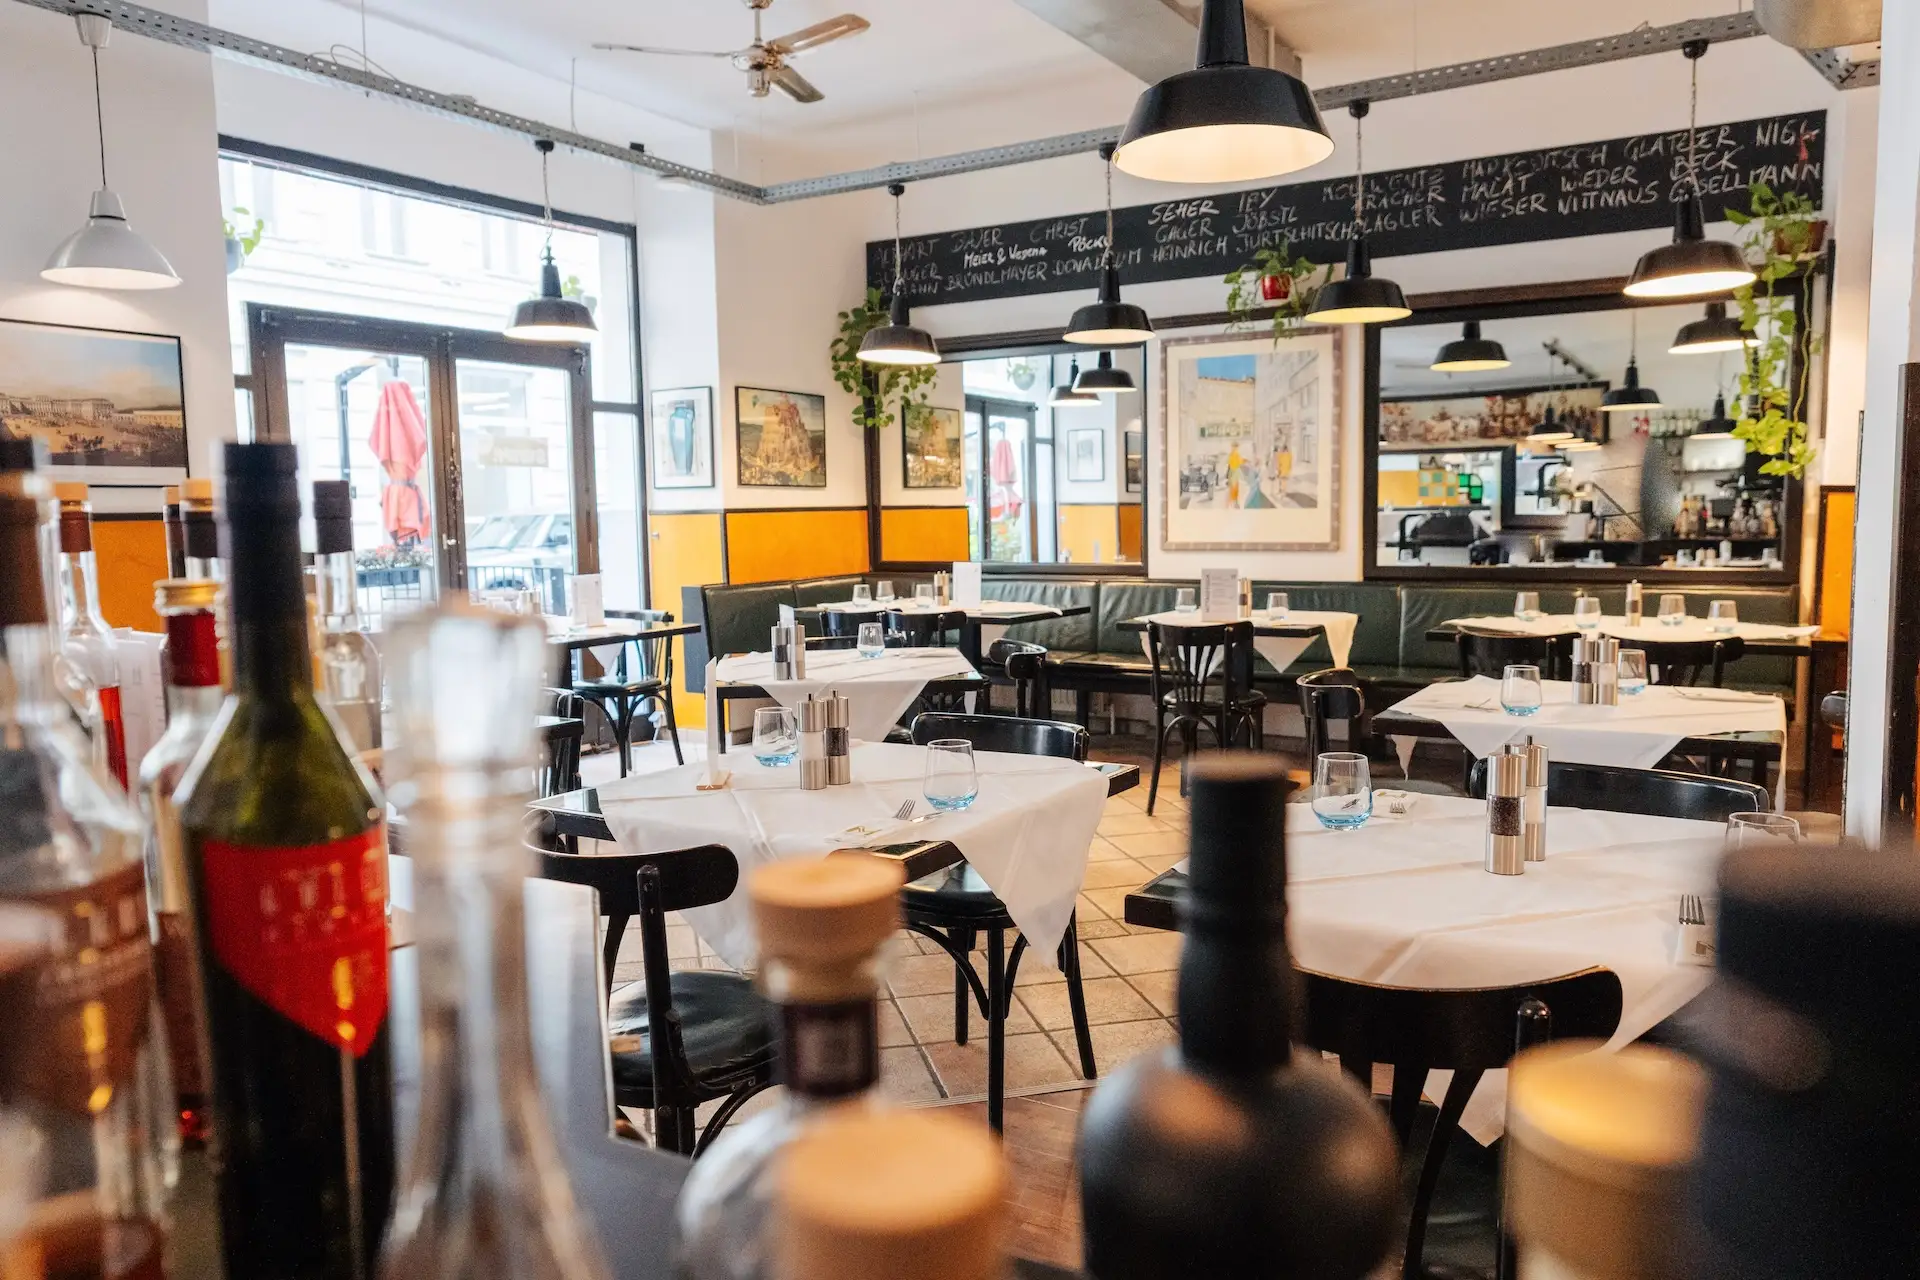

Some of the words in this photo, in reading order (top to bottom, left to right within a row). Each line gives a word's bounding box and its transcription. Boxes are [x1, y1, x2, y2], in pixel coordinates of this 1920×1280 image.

[945, 261, 1048, 291] BRÜNDLMAYER
[1052, 247, 1142, 276] DONABUM
[1150, 235, 1228, 262] HEINRICH
[1363, 204, 1444, 234] LAGLER
[1557, 180, 1660, 215] NITTNAUS
[997, 247, 1006, 266] &
[1669, 144, 1745, 181] BECK
[1029, 217, 1089, 243] CHRIST
[1147, 199, 1220, 225] SEHER
[1624, 125, 1737, 162] GLATZER
